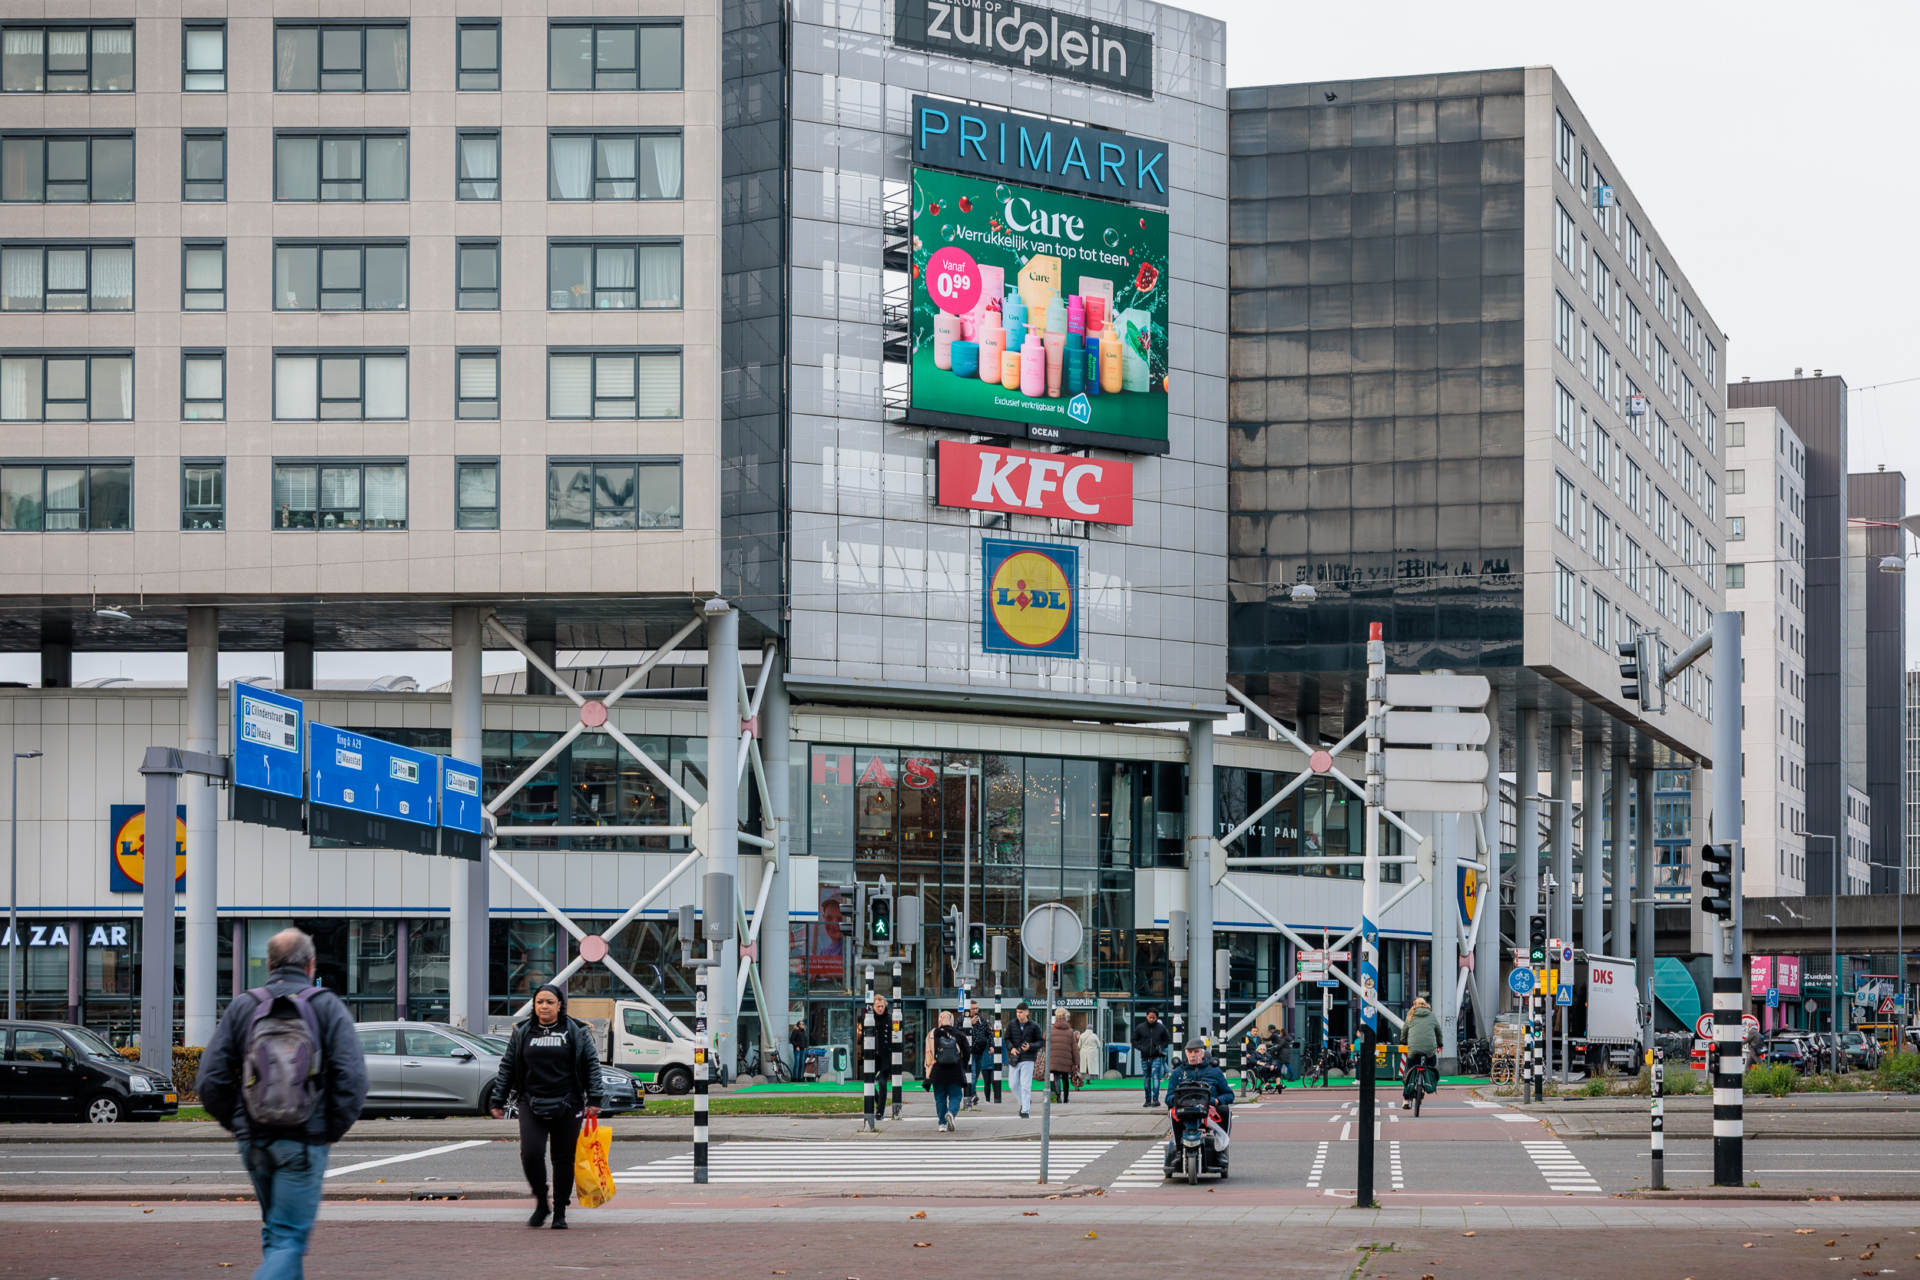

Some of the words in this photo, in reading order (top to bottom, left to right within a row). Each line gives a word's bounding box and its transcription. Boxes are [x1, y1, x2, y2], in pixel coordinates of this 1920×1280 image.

[985, 1, 1002, 12] OP
[921, 107, 1164, 194] PRIMARK
[1004, 197, 1084, 241] Care
[957, 225, 1028, 251] Verrukkelijk
[1030, 241, 1053, 254] van
[1055, 243, 1077, 259] top
[1079, 247, 1097, 260] tot
[1099, 250, 1129, 267] teen.
[942, 259, 966, 272] Vanaf
[1029, 272, 1050, 283] Care
[1031, 427, 1059, 438] OCEAN
[971, 452, 1103, 514] KFC
[352, 738, 362, 749] A29
[1274, 827, 1298, 839] PAN
[1593, 969, 1613, 985] DKS
[1769, 990, 1776, 999] P
[530, 1036, 562, 1046] PUMA
